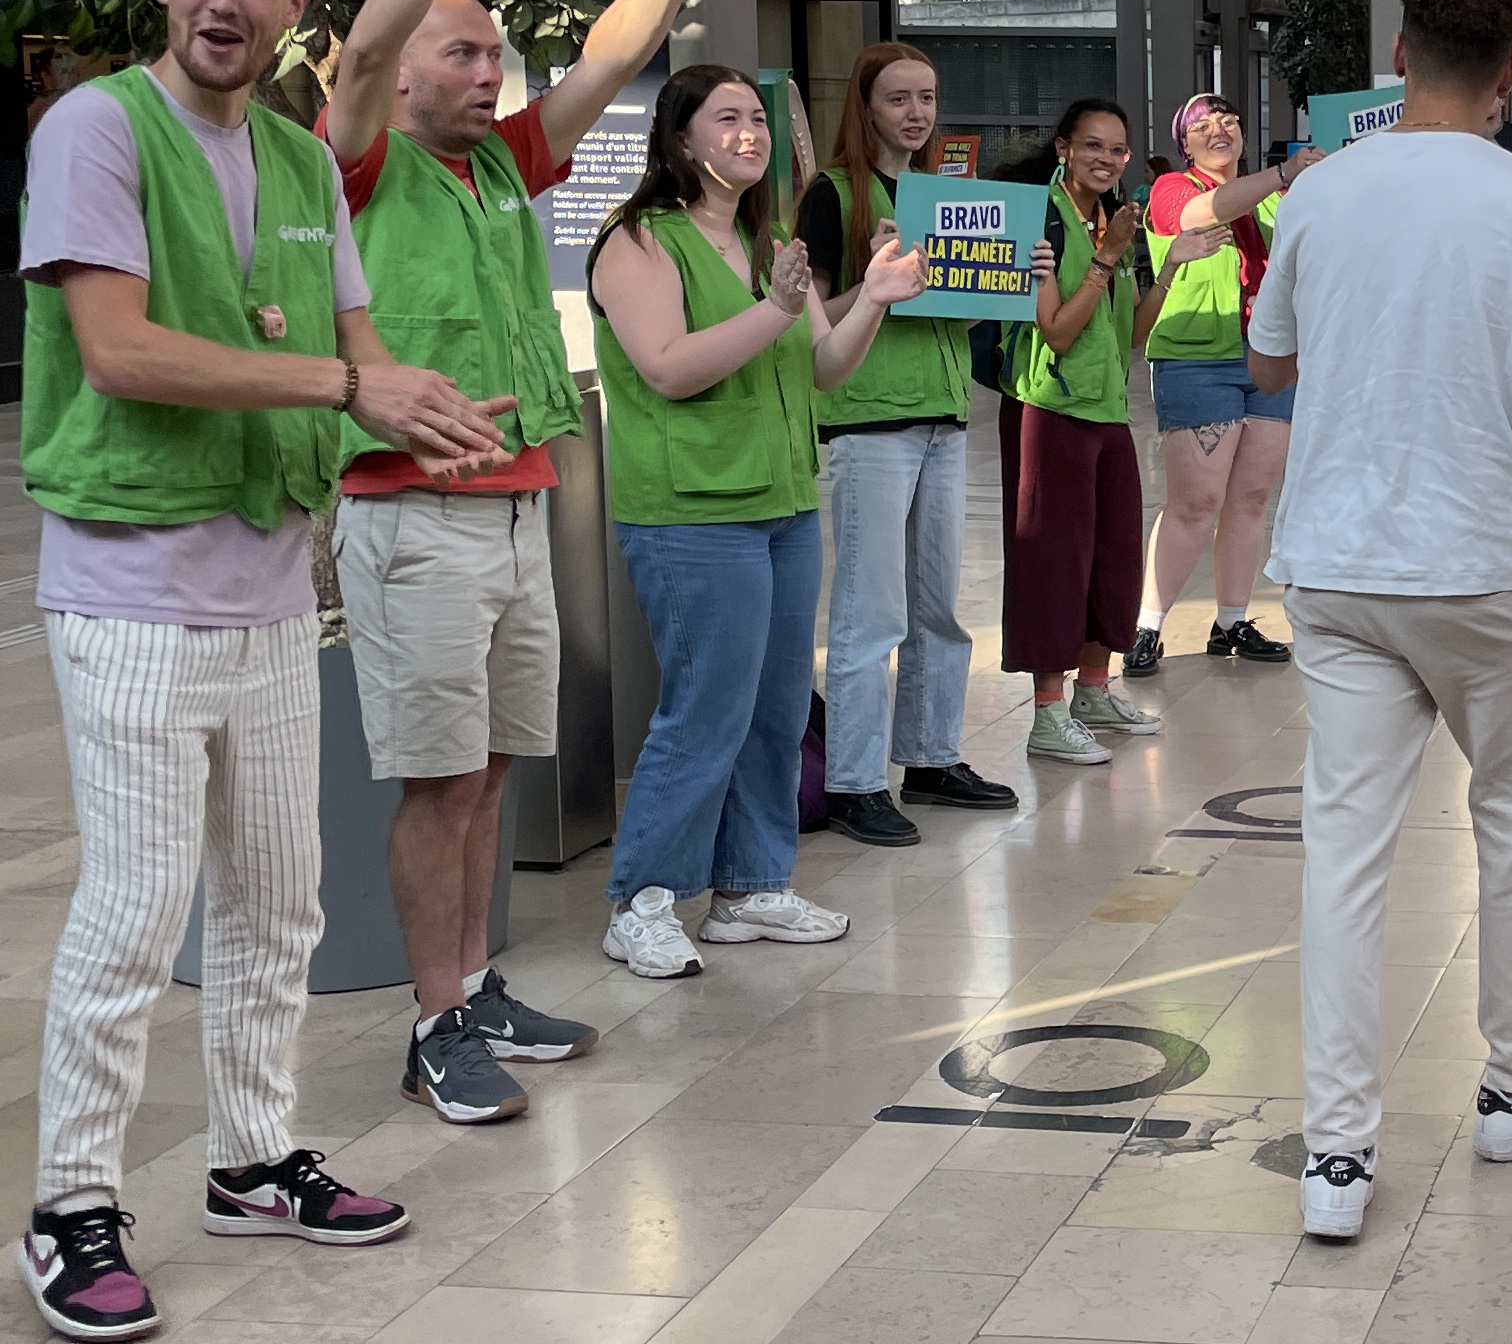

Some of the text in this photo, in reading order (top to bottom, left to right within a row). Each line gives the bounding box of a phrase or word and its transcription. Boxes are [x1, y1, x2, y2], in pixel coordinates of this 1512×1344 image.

[940, 205, 1001, 231] BRAVO
[927, 236, 1014, 265] LA PLANÈTE
[947, 266, 976, 290] DIT
[977, 269, 1022, 293] MERCI
